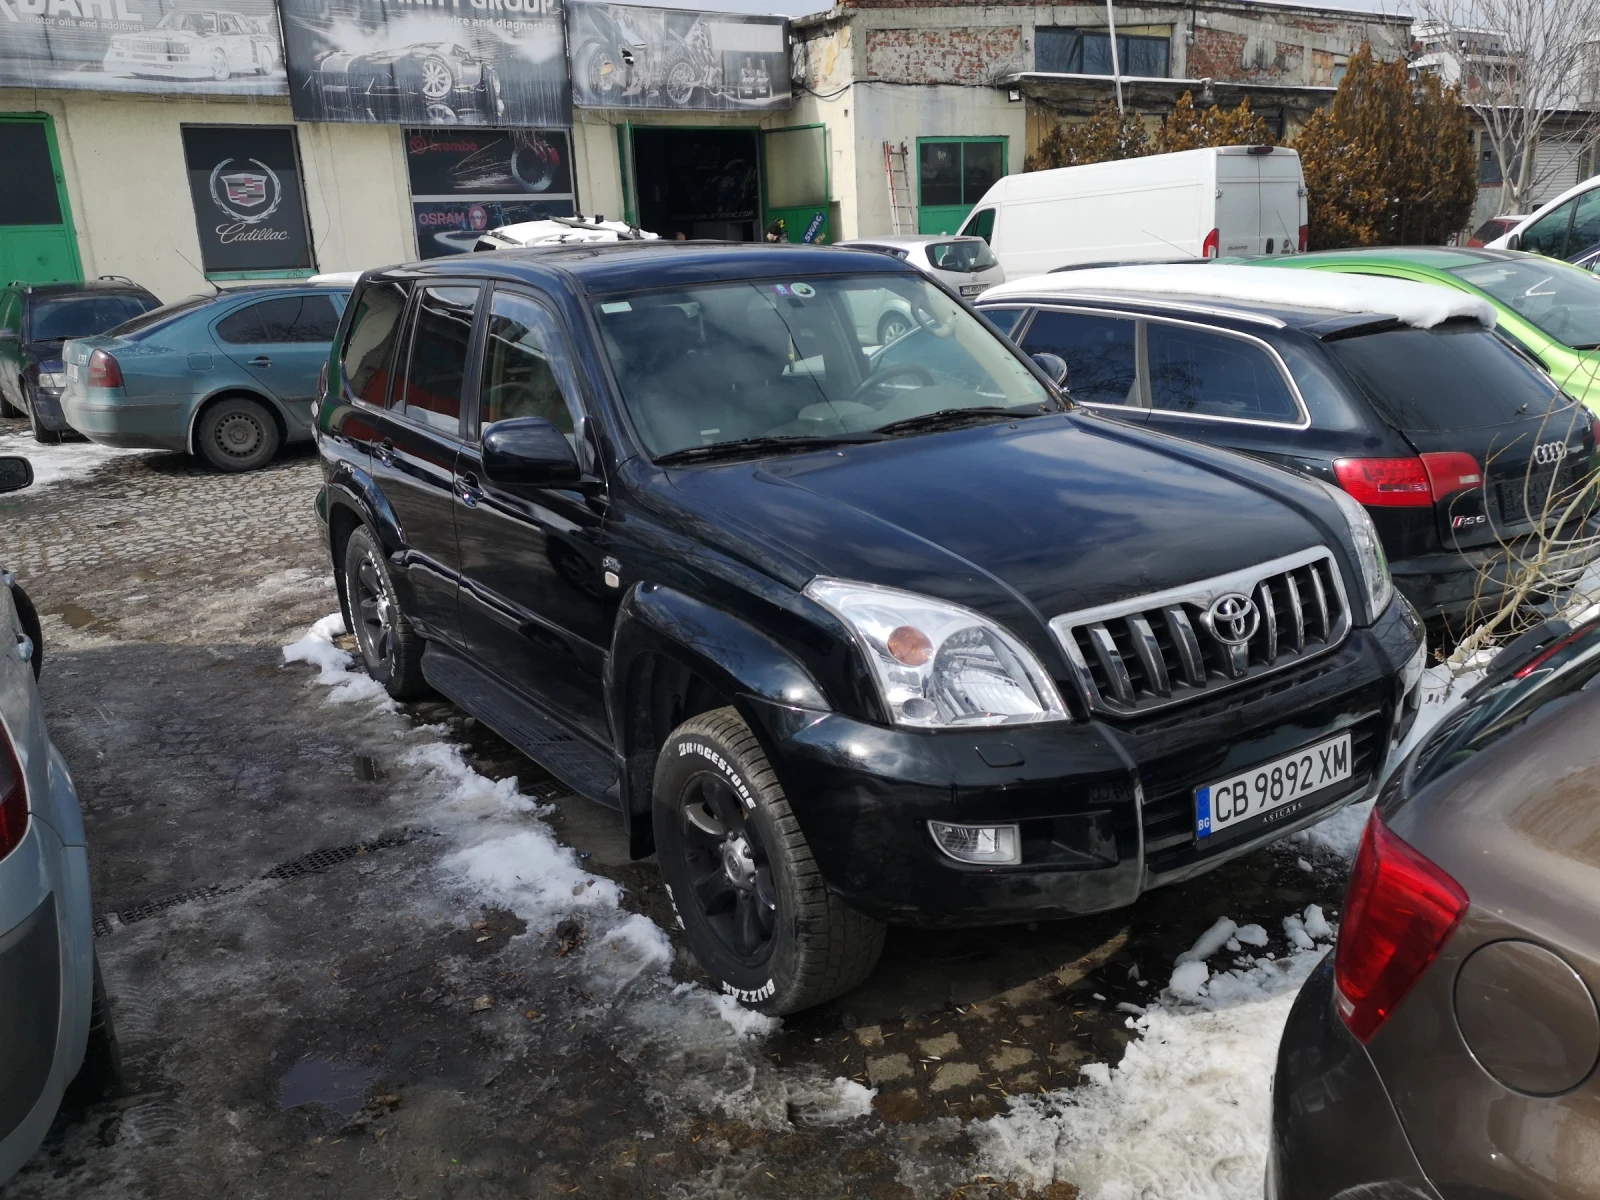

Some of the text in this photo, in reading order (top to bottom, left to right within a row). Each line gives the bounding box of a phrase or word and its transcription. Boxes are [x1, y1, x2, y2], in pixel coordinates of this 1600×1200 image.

[25, 15, 145, 31] motor oils and additives
[472, 17, 494, 27] and
[496, 18, 557, 31] diagnostics
[429, 139, 478, 152] brembo
[418, 212, 466, 225] OSRAM
[215, 222, 288, 244] Cadillac
[803, 214, 823, 243] SWAG
[678, 742, 757, 810] BRIDGESTONE
[1215, 740, 1348, 823] CB 9892 XM
[1262, 802, 1304, 824] ASICARS
[1198, 816, 1211, 832] BG
